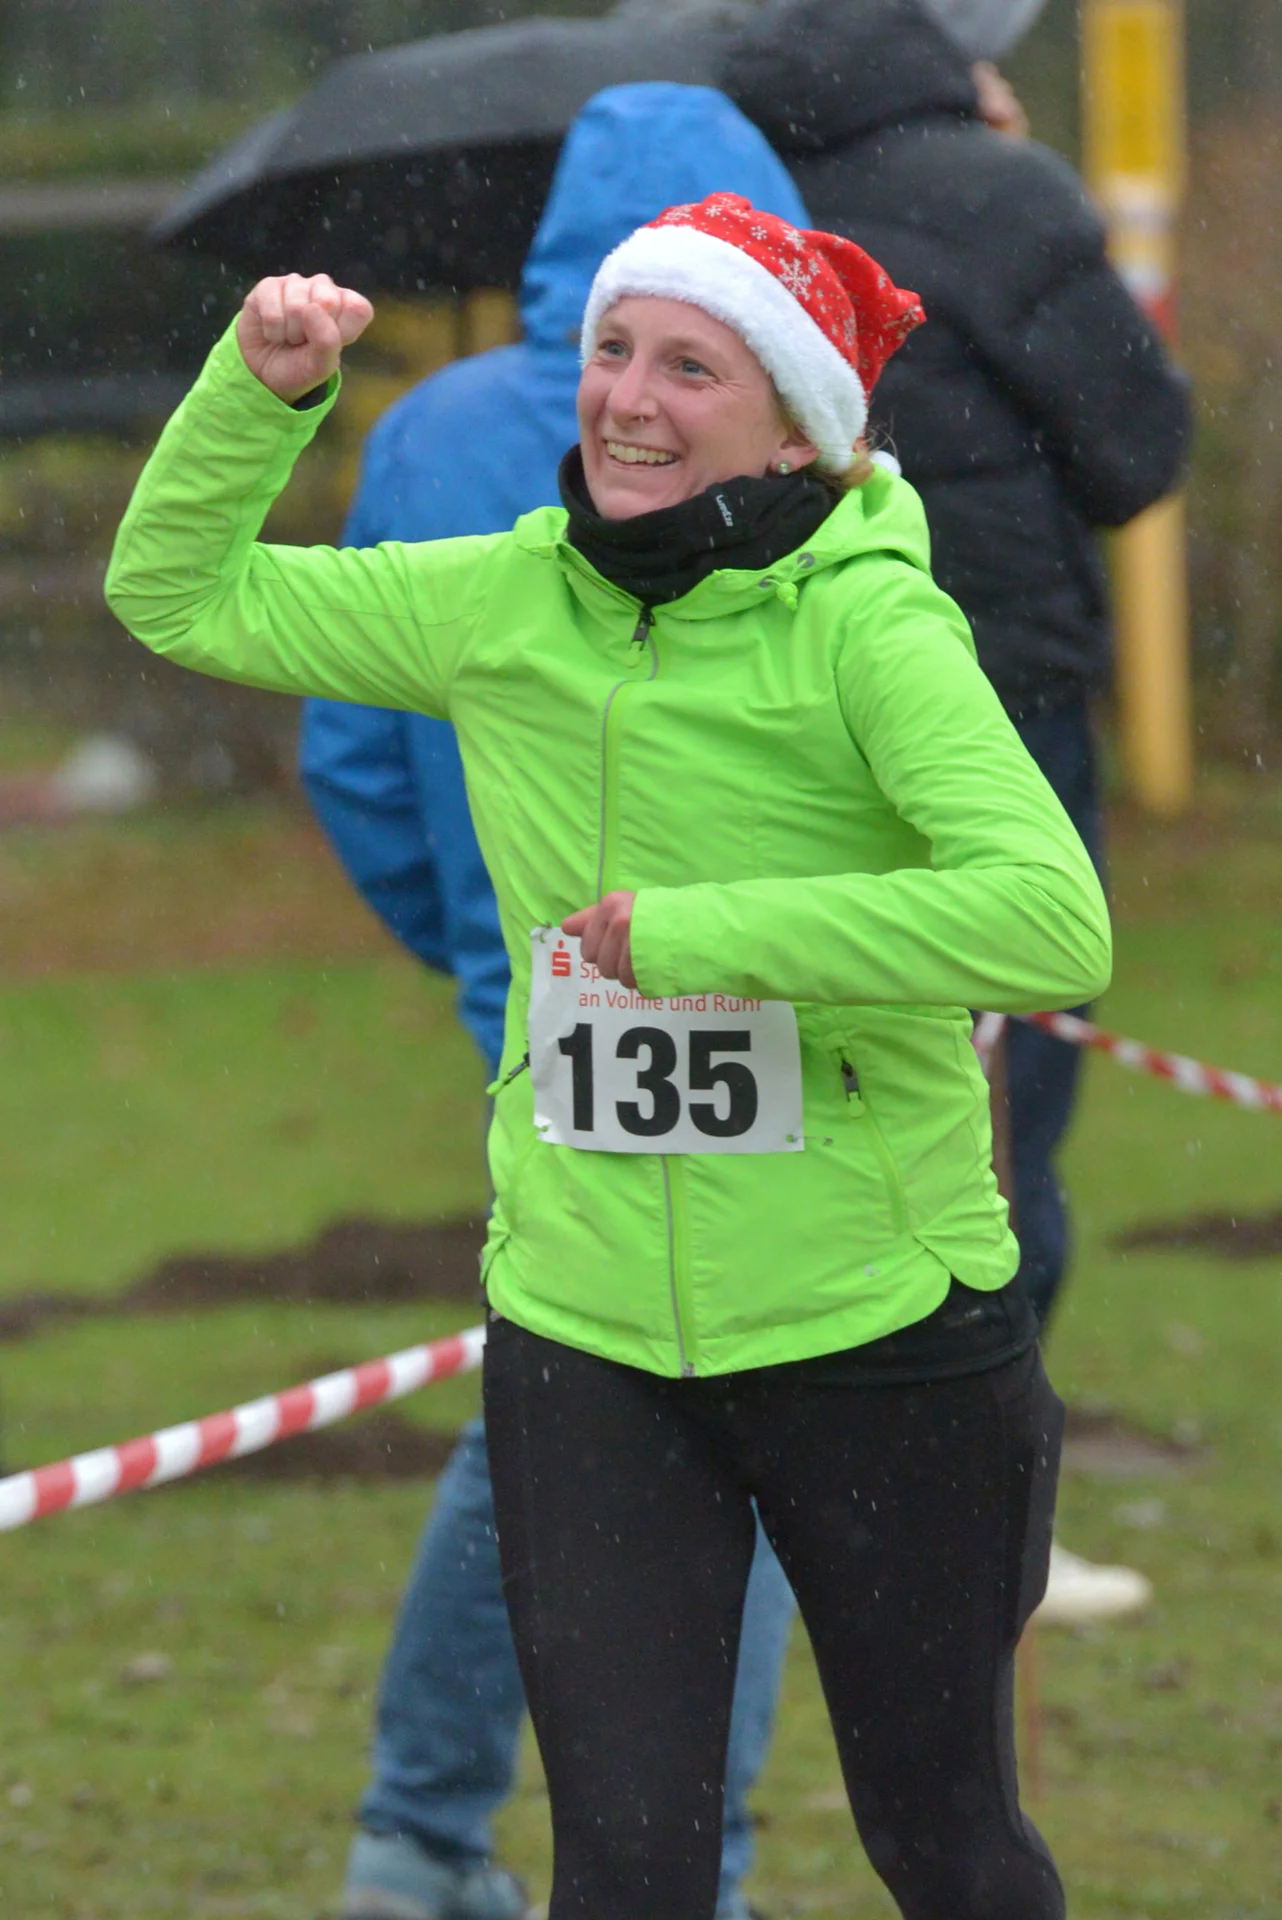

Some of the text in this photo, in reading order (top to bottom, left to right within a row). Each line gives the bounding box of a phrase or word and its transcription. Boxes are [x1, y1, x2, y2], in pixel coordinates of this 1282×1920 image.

[578, 992, 600, 1008] an
[604, 989, 664, 1011] Volme
[669, 994, 707, 1012] und
[558, 1022, 758, 1138] 135
